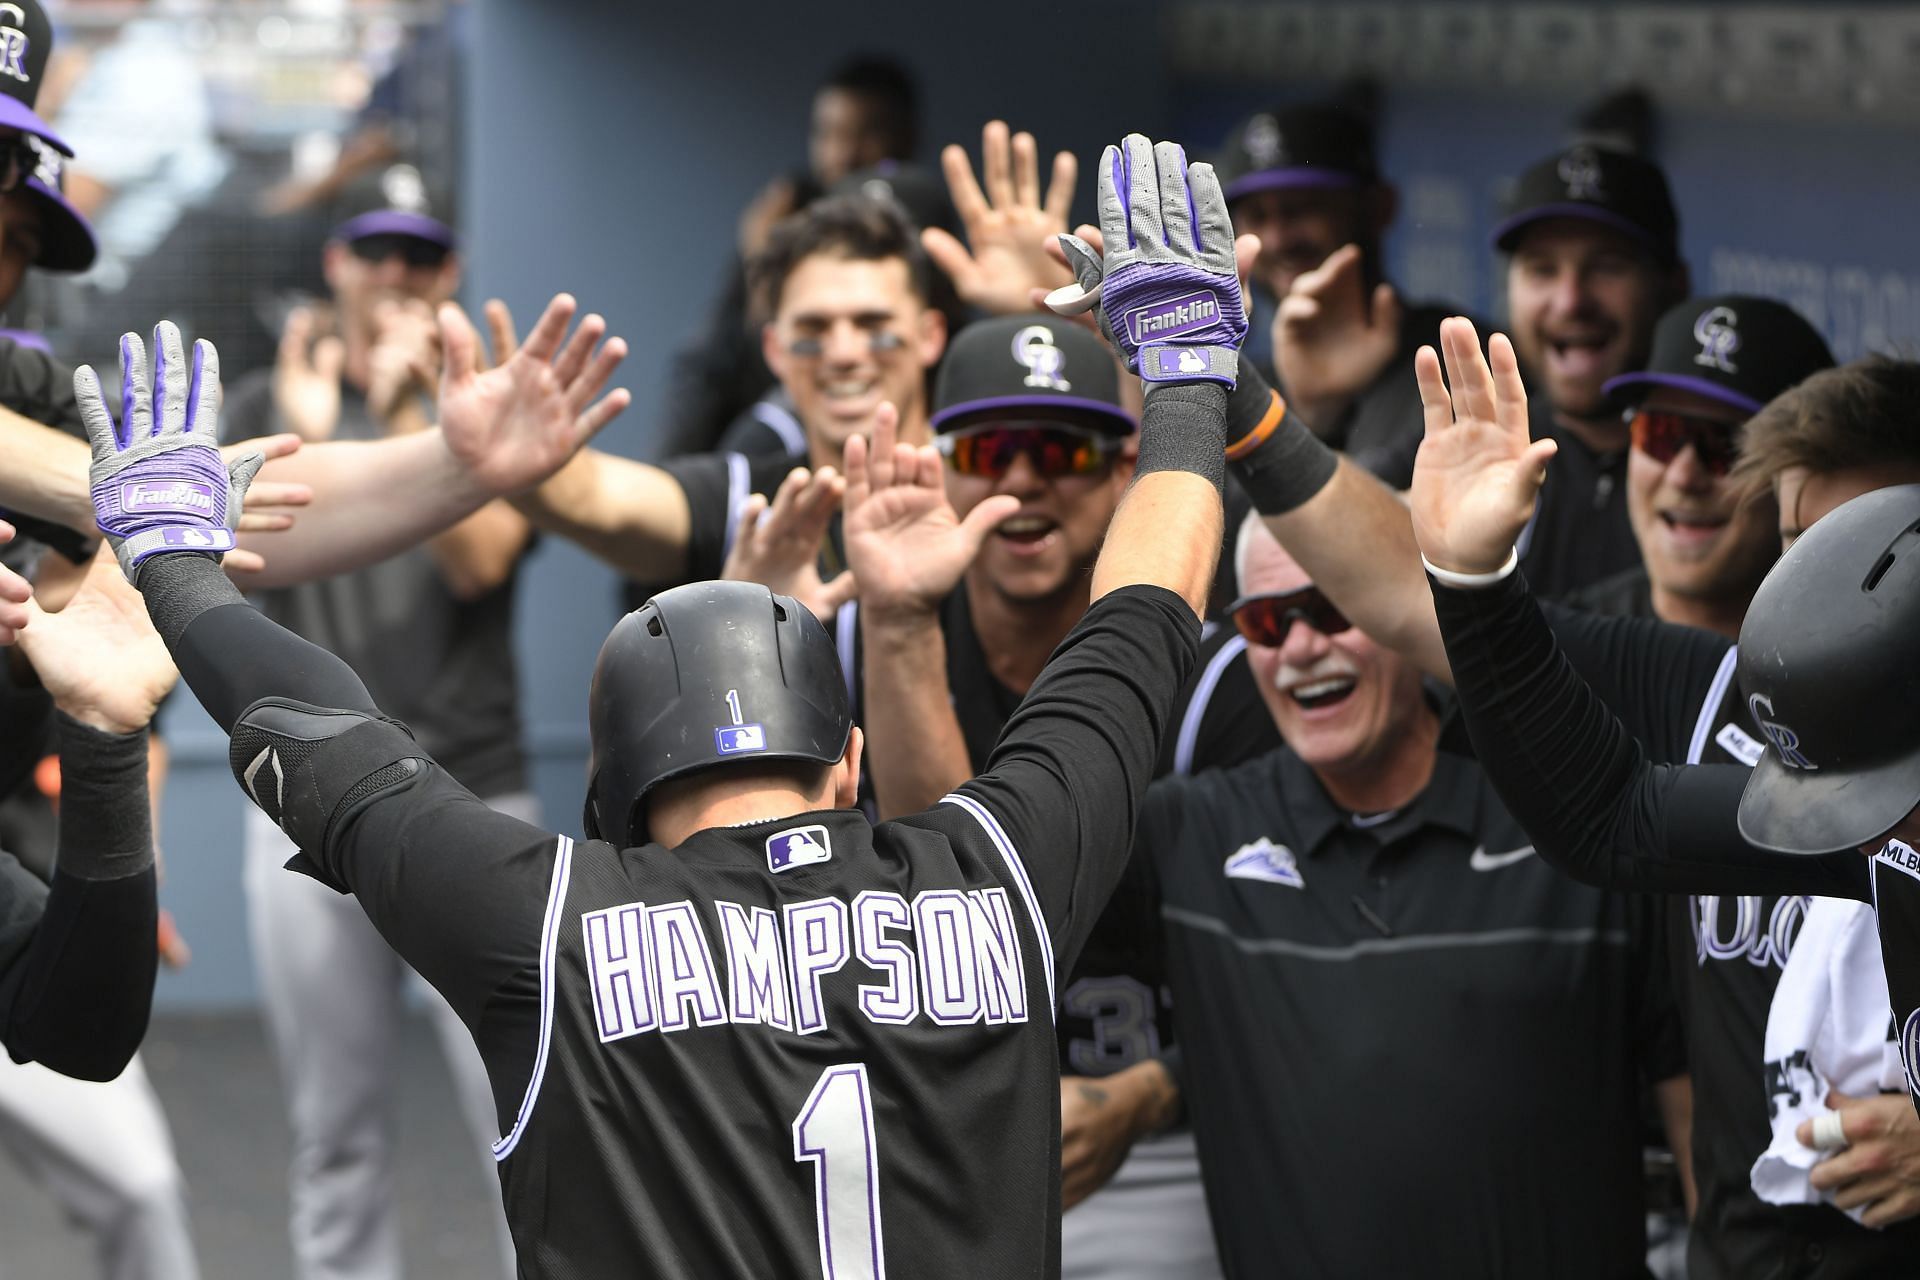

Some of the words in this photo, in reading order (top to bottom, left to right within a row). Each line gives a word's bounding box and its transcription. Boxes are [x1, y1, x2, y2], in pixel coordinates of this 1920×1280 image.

[1135, 300, 1215, 341] Franklin
[127, 484, 212, 509] Franklin
[726, 689, 744, 725] 1
[1881, 842, 1920, 876] MLB
[581, 887, 1028, 1043] HAMPSON
[792, 1062, 886, 1280] 1
